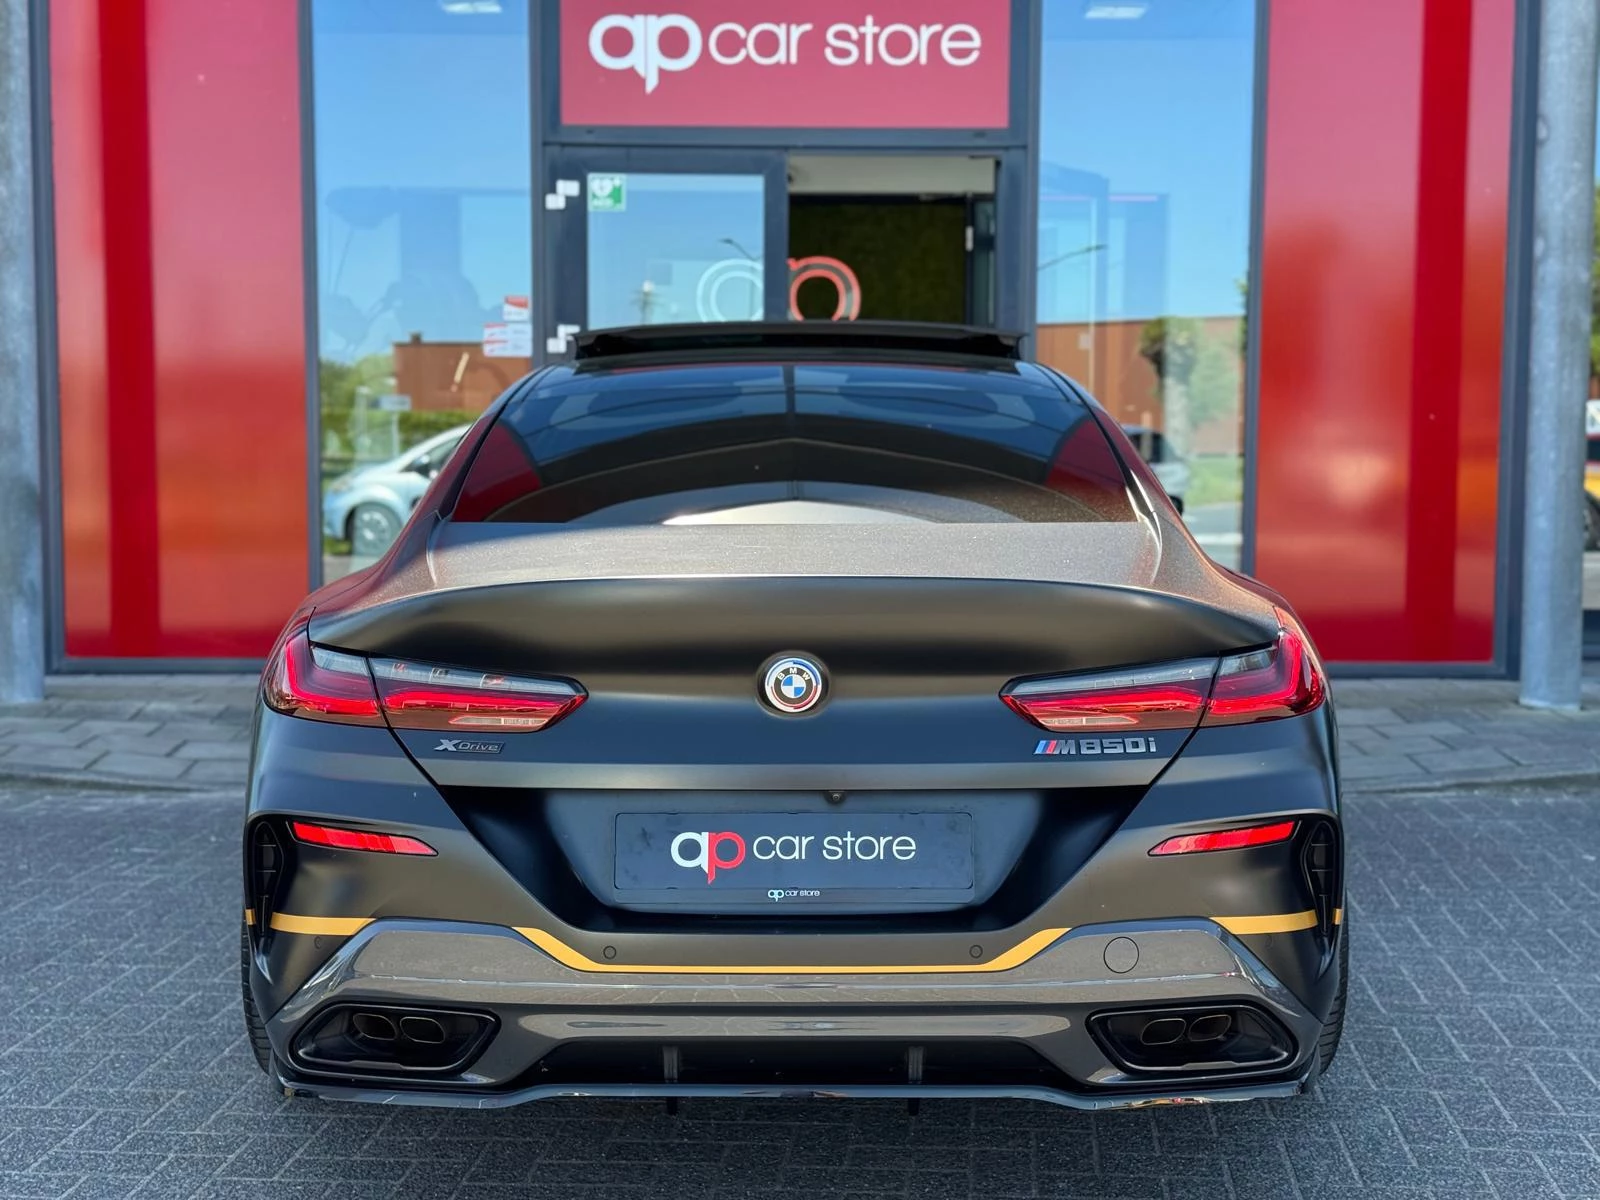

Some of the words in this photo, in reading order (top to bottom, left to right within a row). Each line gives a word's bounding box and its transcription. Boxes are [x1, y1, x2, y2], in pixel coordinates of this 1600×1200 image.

[708, 22, 813, 66] car
[824, 15, 982, 67] store
[777, 667, 811, 681] BMW
[752, 835, 815, 861] car
[822, 831, 917, 861] store
